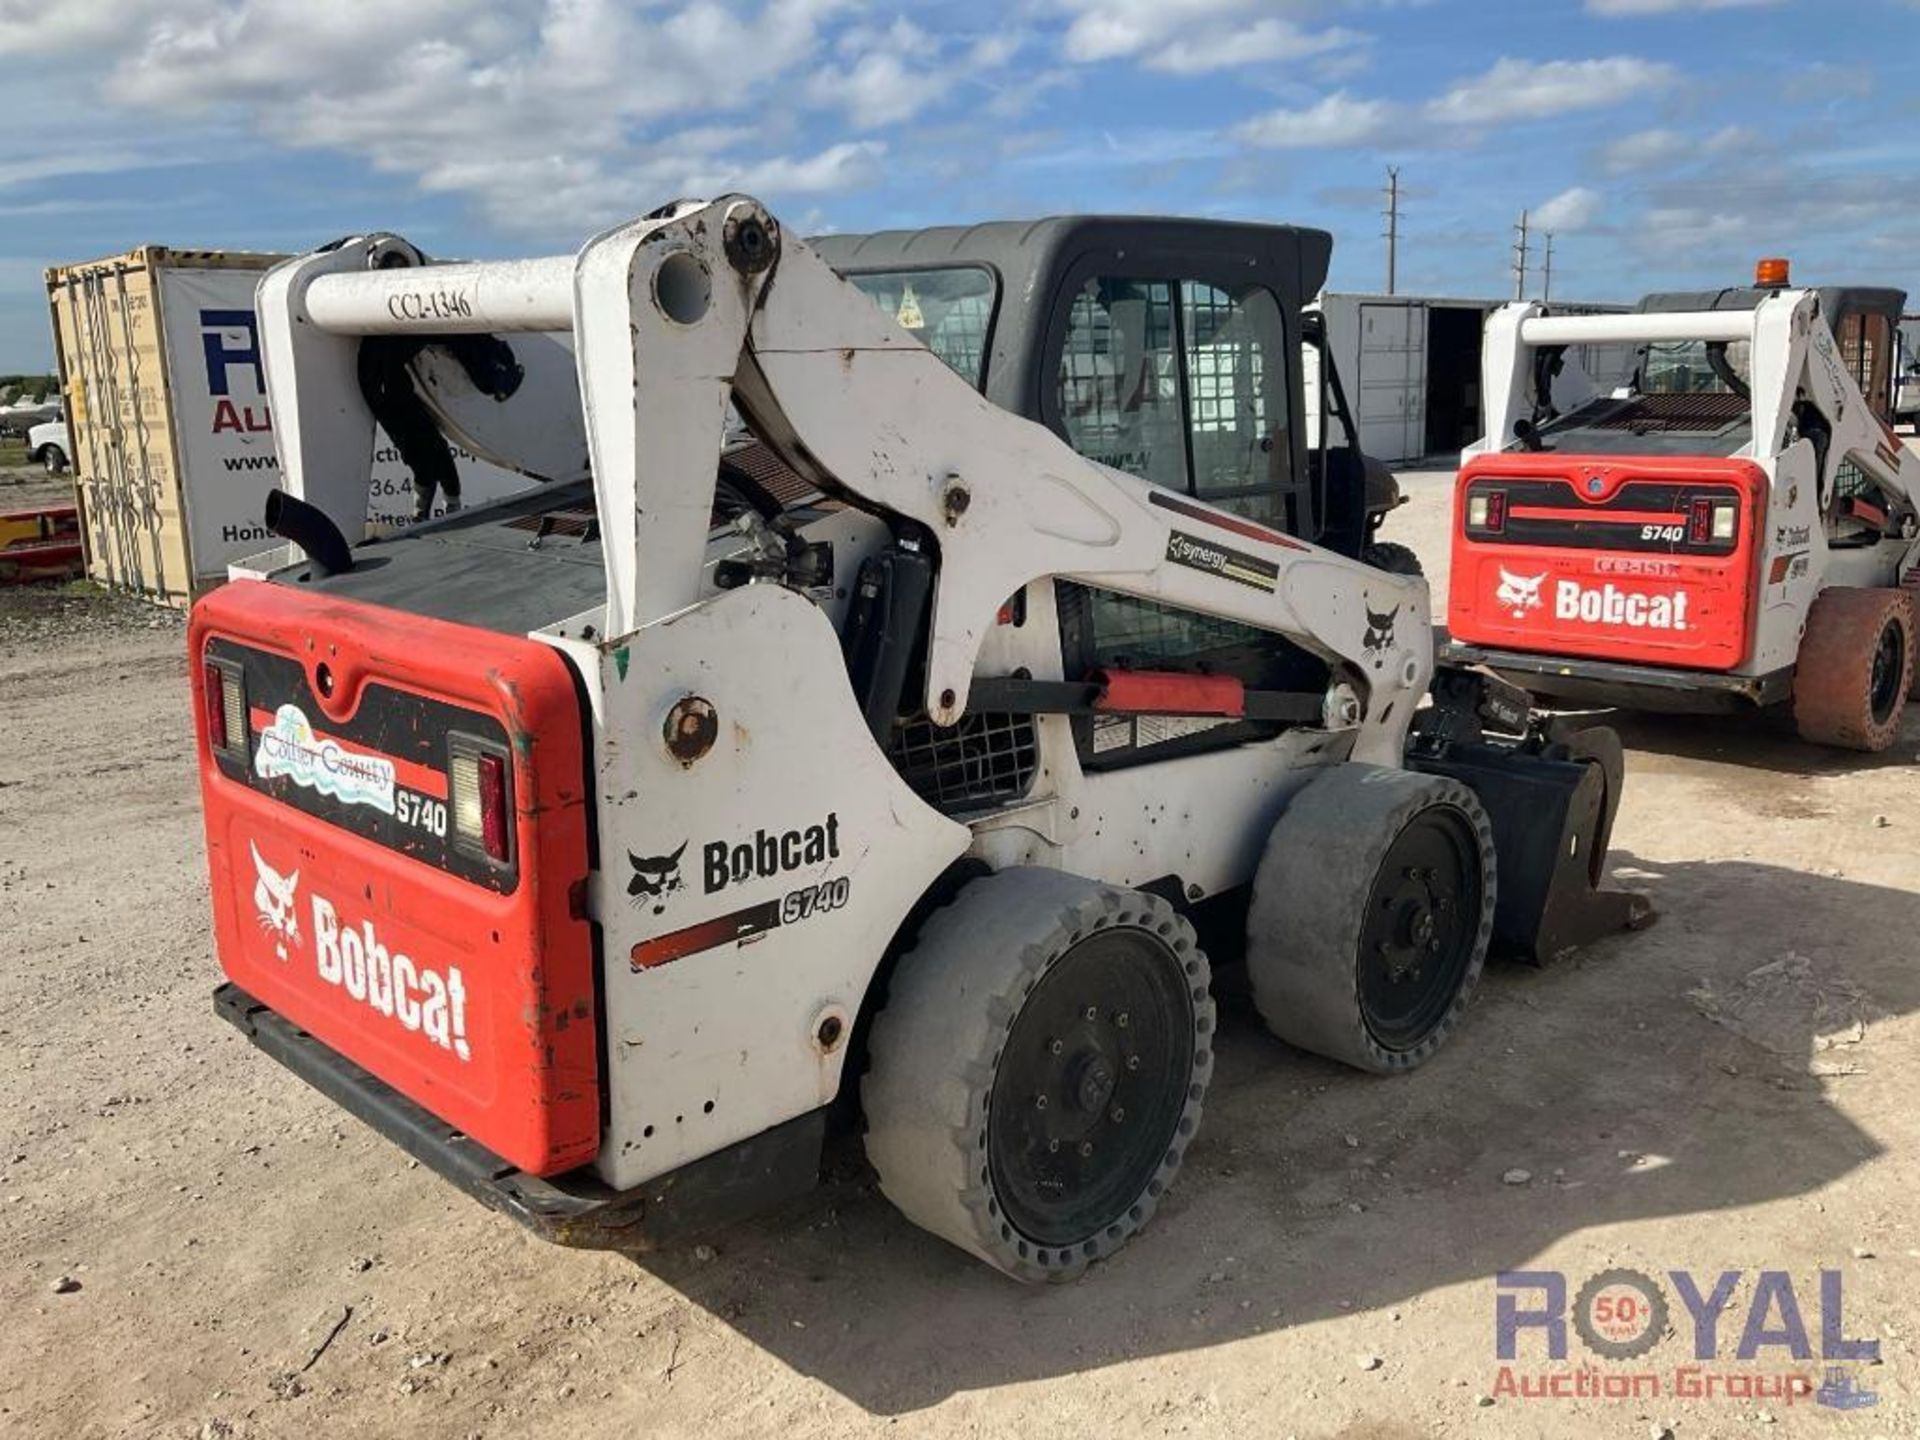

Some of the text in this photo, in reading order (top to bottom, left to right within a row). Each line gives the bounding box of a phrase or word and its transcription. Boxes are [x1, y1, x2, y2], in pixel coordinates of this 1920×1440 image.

[388, 290, 472, 320] CC2-1346
[1183, 542, 1228, 571] synergy
[1641, 525, 1683, 541] S740
[1556, 580, 1687, 630] Bobcat
[322, 745, 391, 790] County
[397, 790, 447, 837] S740
[704, 812, 840, 894] Bobcat
[782, 876, 850, 924] S740
[312, 894, 473, 1063] Bobcat
